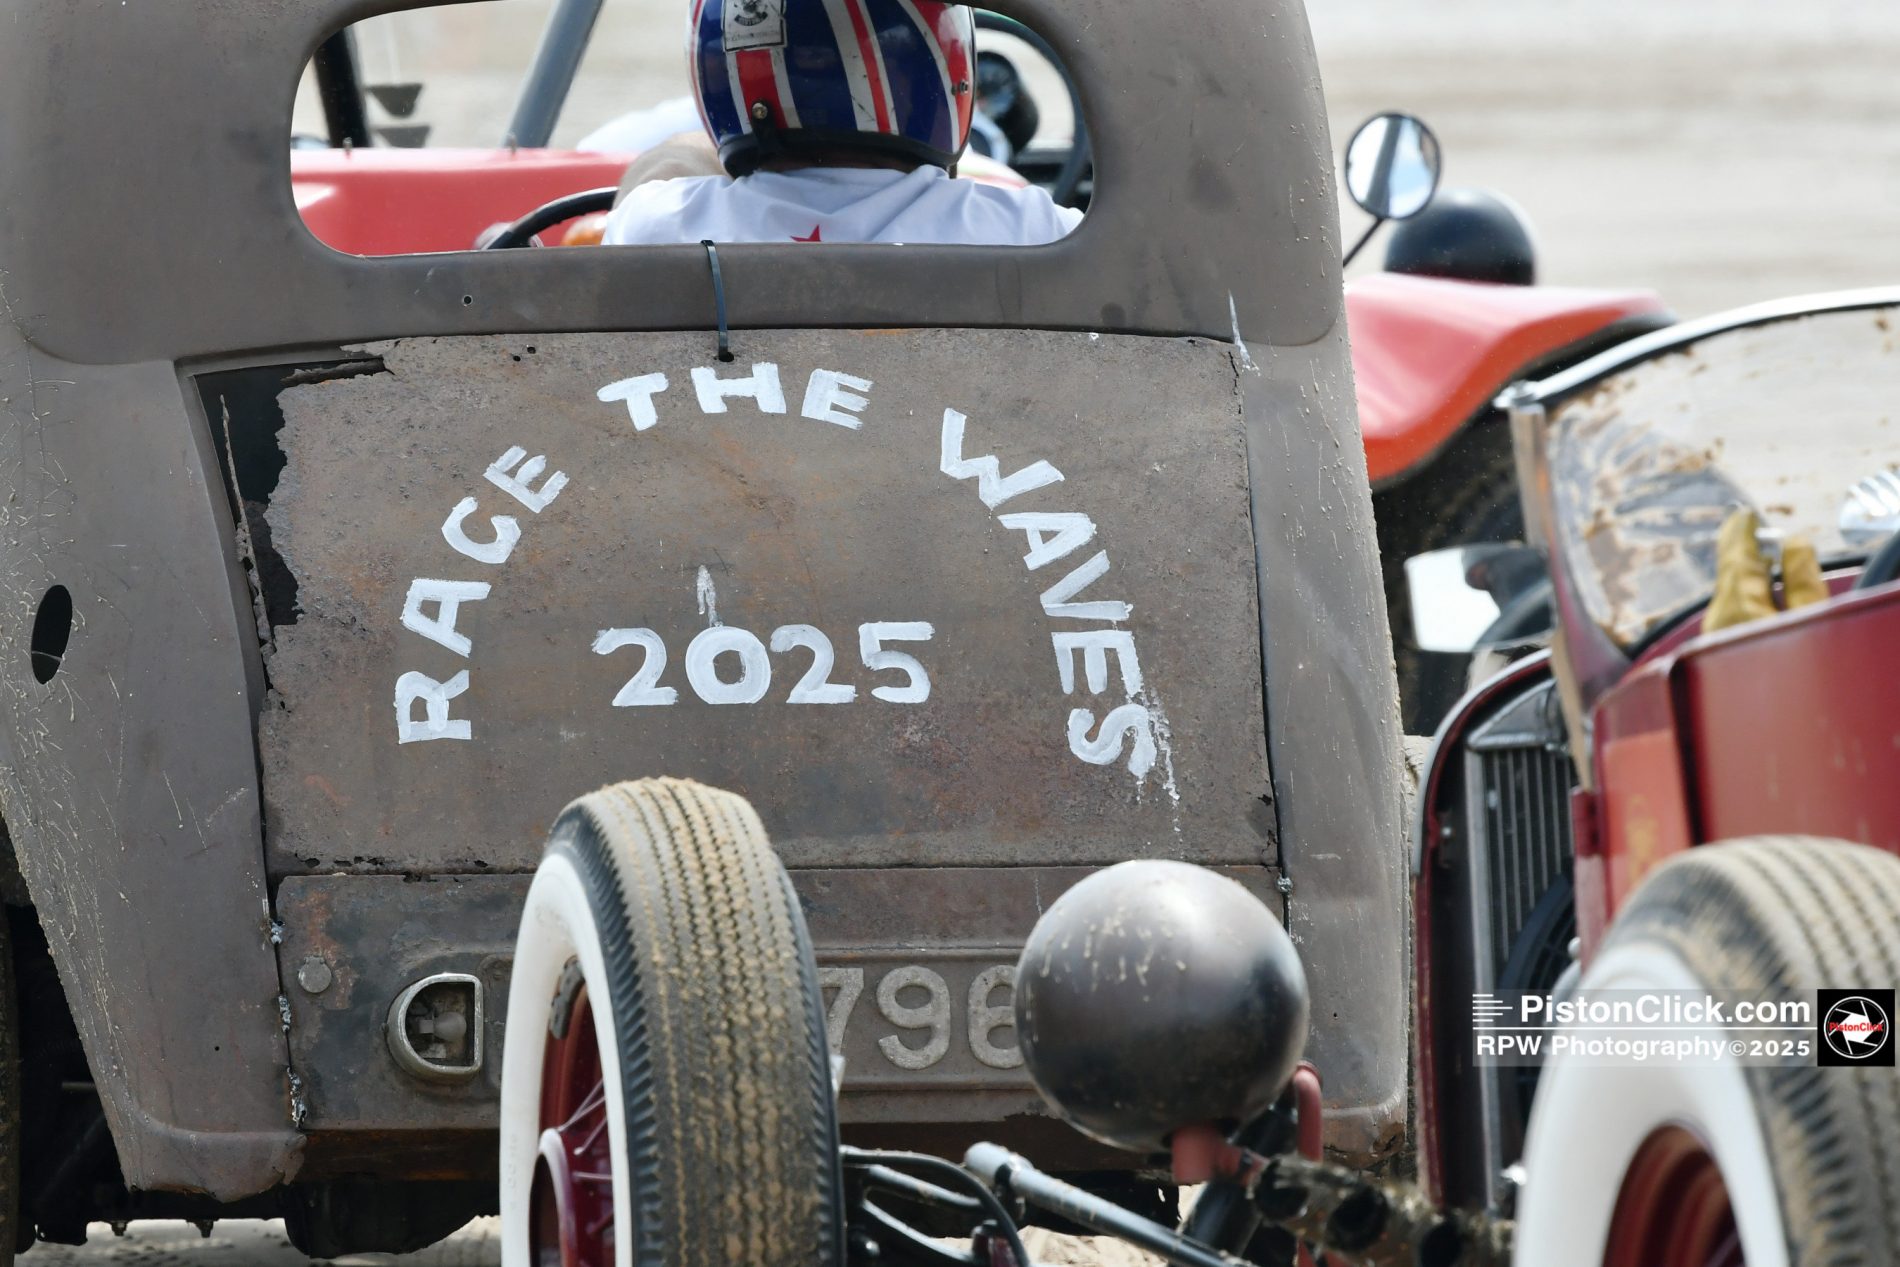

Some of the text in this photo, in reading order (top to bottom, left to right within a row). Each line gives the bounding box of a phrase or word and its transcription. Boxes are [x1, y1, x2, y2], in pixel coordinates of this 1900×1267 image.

[591, 620, 936, 707] 2025
[597, 362, 874, 431] THE
[940, 407, 1158, 780] WAVES
